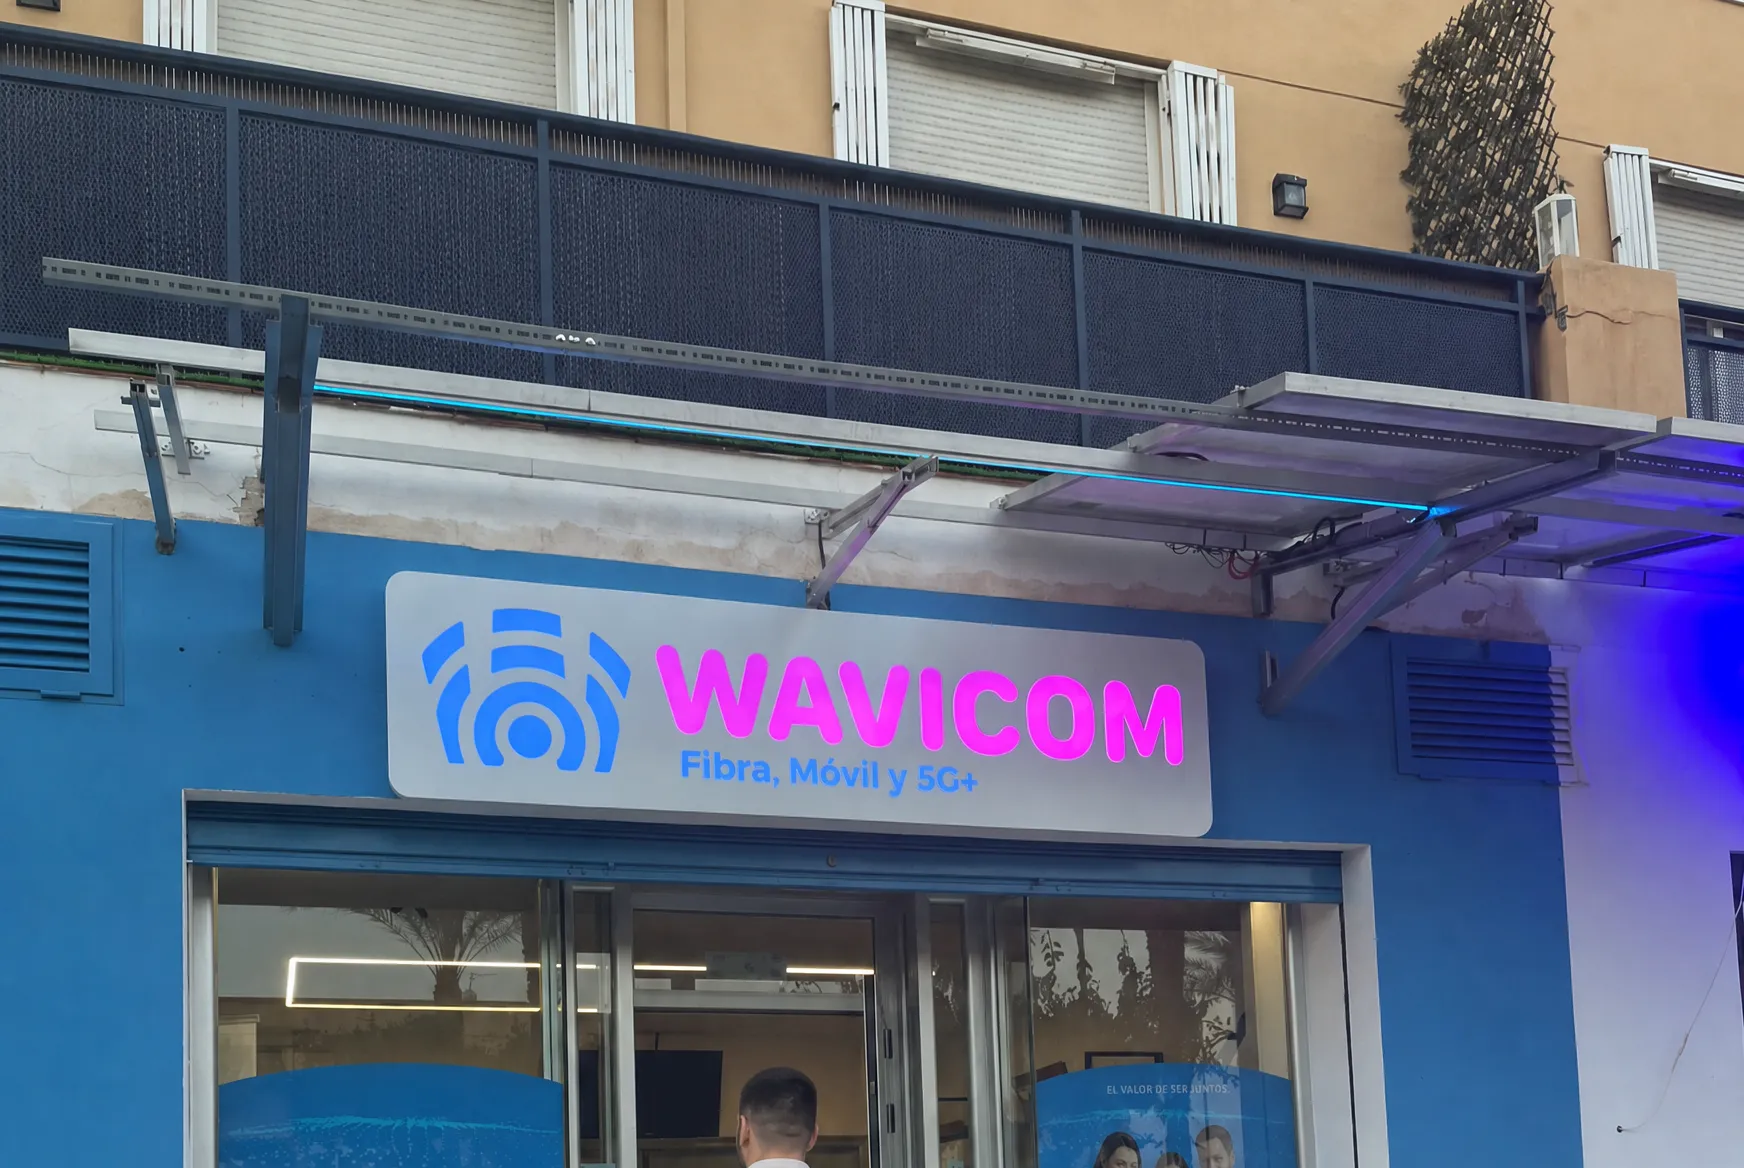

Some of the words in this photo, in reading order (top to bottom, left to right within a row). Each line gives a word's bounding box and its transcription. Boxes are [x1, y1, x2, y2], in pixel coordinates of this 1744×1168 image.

[655, 644, 1185, 767] WAVICOM
[681, 749, 780, 788] Fibra,
[789, 756, 879, 789] Móvil
[887, 767, 908, 798] y
[917, 765, 978, 793] 5G+
[1106, 1085, 1119, 1095] EL
[1120, 1084, 1153, 1095] VALOR
[1155, 1084, 1168, 1094] DE
[1170, 1084, 1188, 1094] SER
